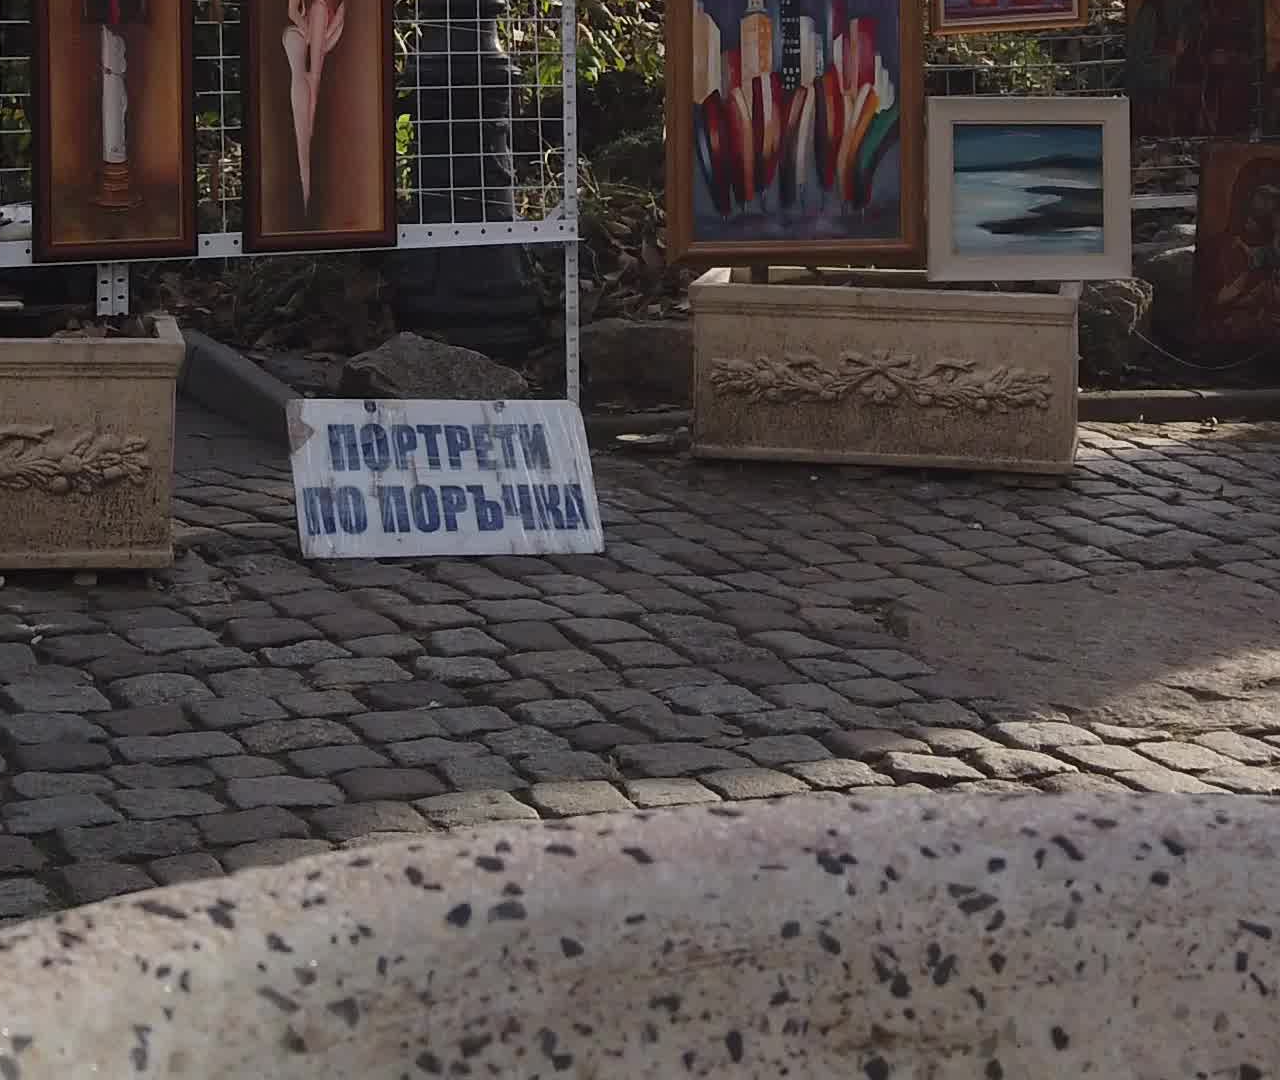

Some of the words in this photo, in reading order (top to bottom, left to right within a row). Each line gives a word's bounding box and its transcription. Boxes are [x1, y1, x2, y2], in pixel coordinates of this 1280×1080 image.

[327, 423, 551, 472] ПОРТРЕТИ
[302, 484, 368, 536] ПО
[376, 483, 591, 534] ПОРЪЧКА
